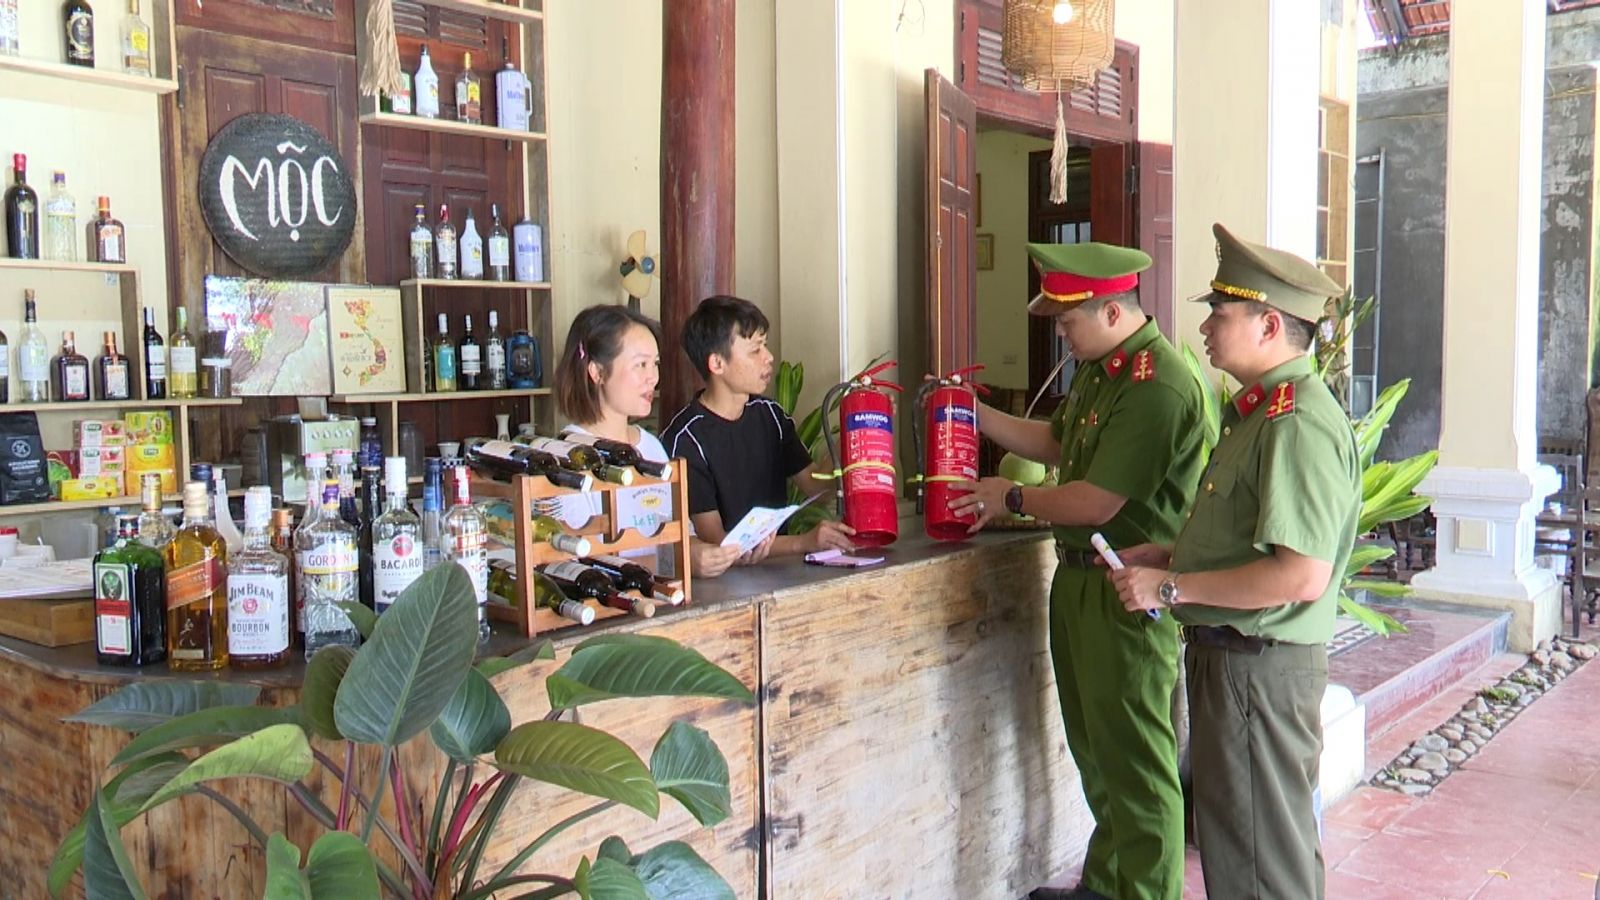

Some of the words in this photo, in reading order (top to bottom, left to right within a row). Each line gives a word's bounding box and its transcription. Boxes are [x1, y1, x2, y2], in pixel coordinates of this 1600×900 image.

[854, 413, 889, 423] SAMWOO
[229, 585, 246, 603] JIM
[246, 582, 274, 602] BEAM
[231, 623, 270, 633] BOURBON
